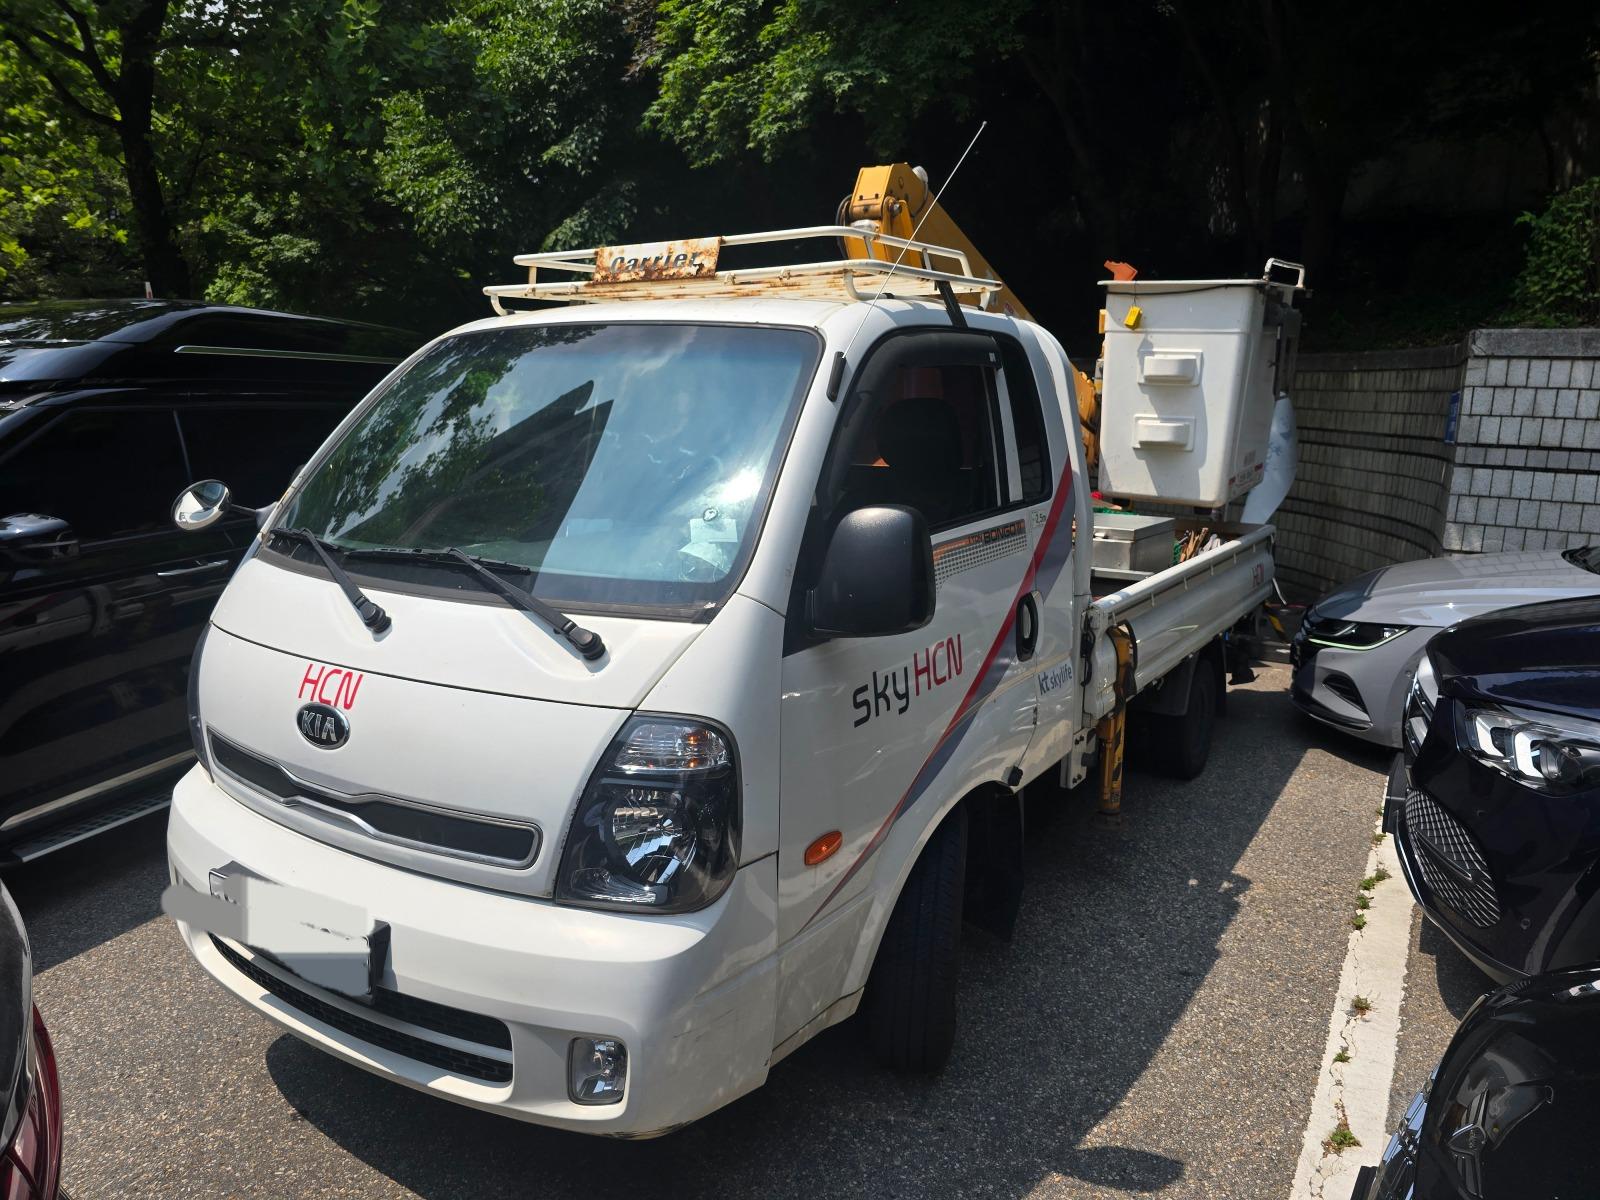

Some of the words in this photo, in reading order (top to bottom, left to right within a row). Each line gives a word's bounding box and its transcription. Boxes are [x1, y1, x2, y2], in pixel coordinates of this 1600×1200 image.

[610, 251, 701, 275] Carrier
[297, 663, 364, 710] HCN
[1050, 664, 1073, 690] skylife
[301, 710, 338, 742] KIA
